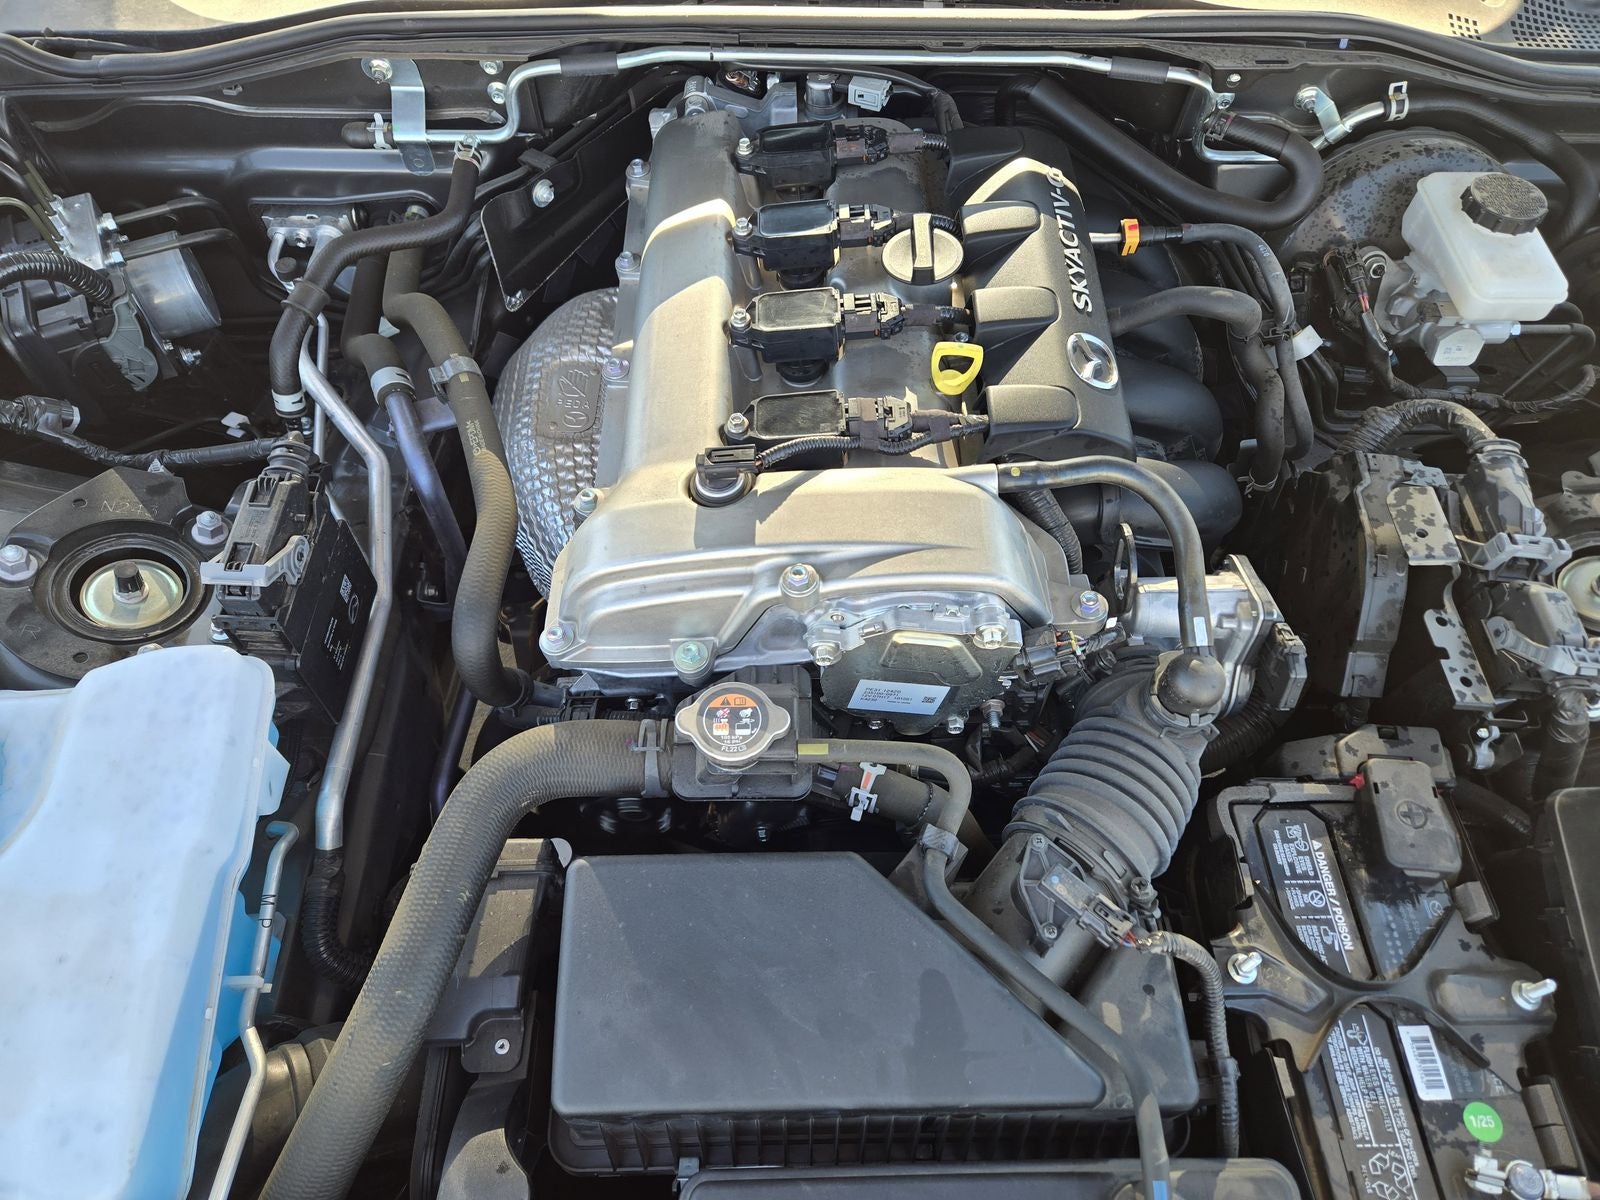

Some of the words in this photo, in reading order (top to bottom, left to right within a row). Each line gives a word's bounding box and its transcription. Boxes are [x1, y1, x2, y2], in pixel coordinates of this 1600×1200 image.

[1047, 167, 1093, 313] SKYACTIV-G
[1315, 852, 1337, 896] DANGER
[1332, 907, 1354, 950] POISON
[1350, 1046, 1362, 1075] MEDICAL
[1358, 1076, 1368, 1094] HELP
[1364, 1095, 1373, 1112] FAST
[1369, 1090, 1378, 1104] GET
[1370, 1068, 1380, 1086] EYES
[1469, 1115, 1495, 1128] 1/25
